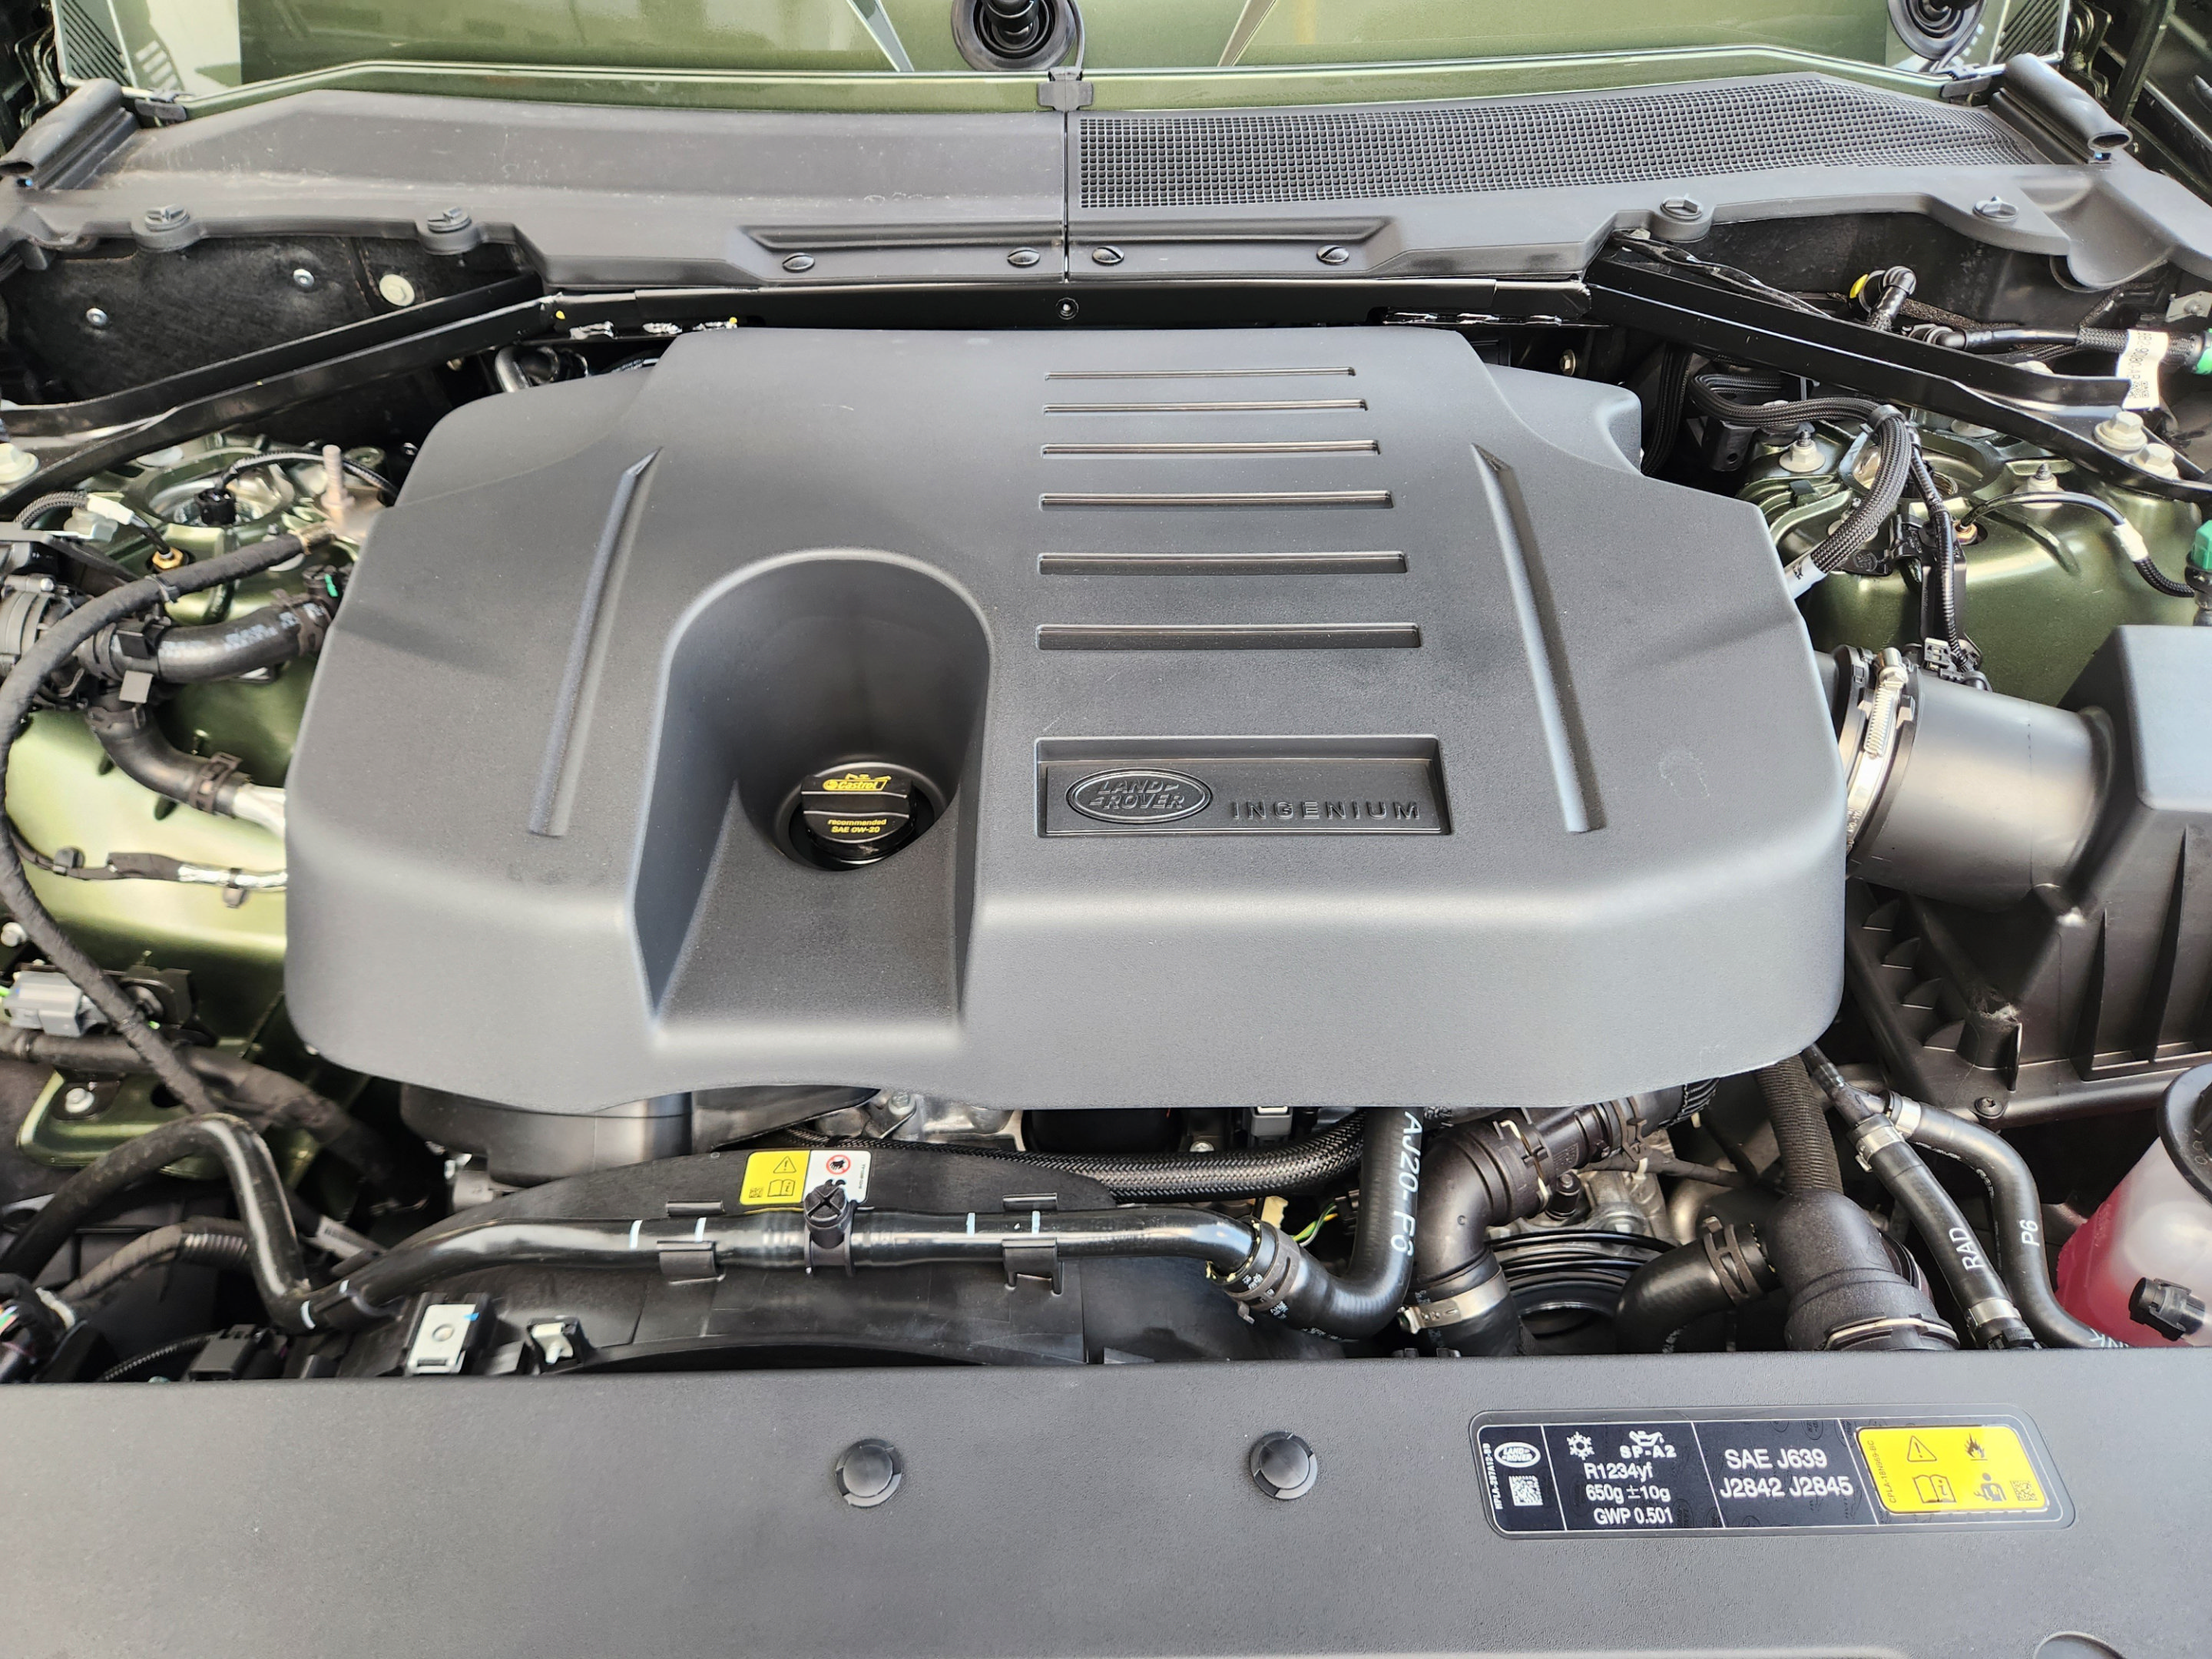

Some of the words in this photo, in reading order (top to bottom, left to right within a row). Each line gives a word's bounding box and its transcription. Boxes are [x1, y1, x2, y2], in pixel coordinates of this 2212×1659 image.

[838, 781, 879, 790] Castrol
[1098, 780, 1164, 795] LAND
[1103, 793, 1185, 810] ROVER
[1230, 800, 1421, 820] INGENIUM
[2019, 1220, 2040, 1247] P6
[1949, 1227, 1985, 1272] RAD
[1508, 1453, 1532, 1462] ROVER
[1619, 1445, 1677, 1459] SP-A2
[1724, 1449, 1773, 1469] SAE
[1777, 1448, 1828, 1469] J639
[1583, 1461, 1654, 1483] R1234yf
[1585, 1484, 1624, 1504] 650g
[1626, 1484, 1671, 1502] ±10g
[1720, 1476, 1786, 1498] J2842
[1789, 1475, 1855, 1497] J2845
[1593, 1507, 1631, 1525] GWP
[1634, 1506, 1674, 1525] 0.501
